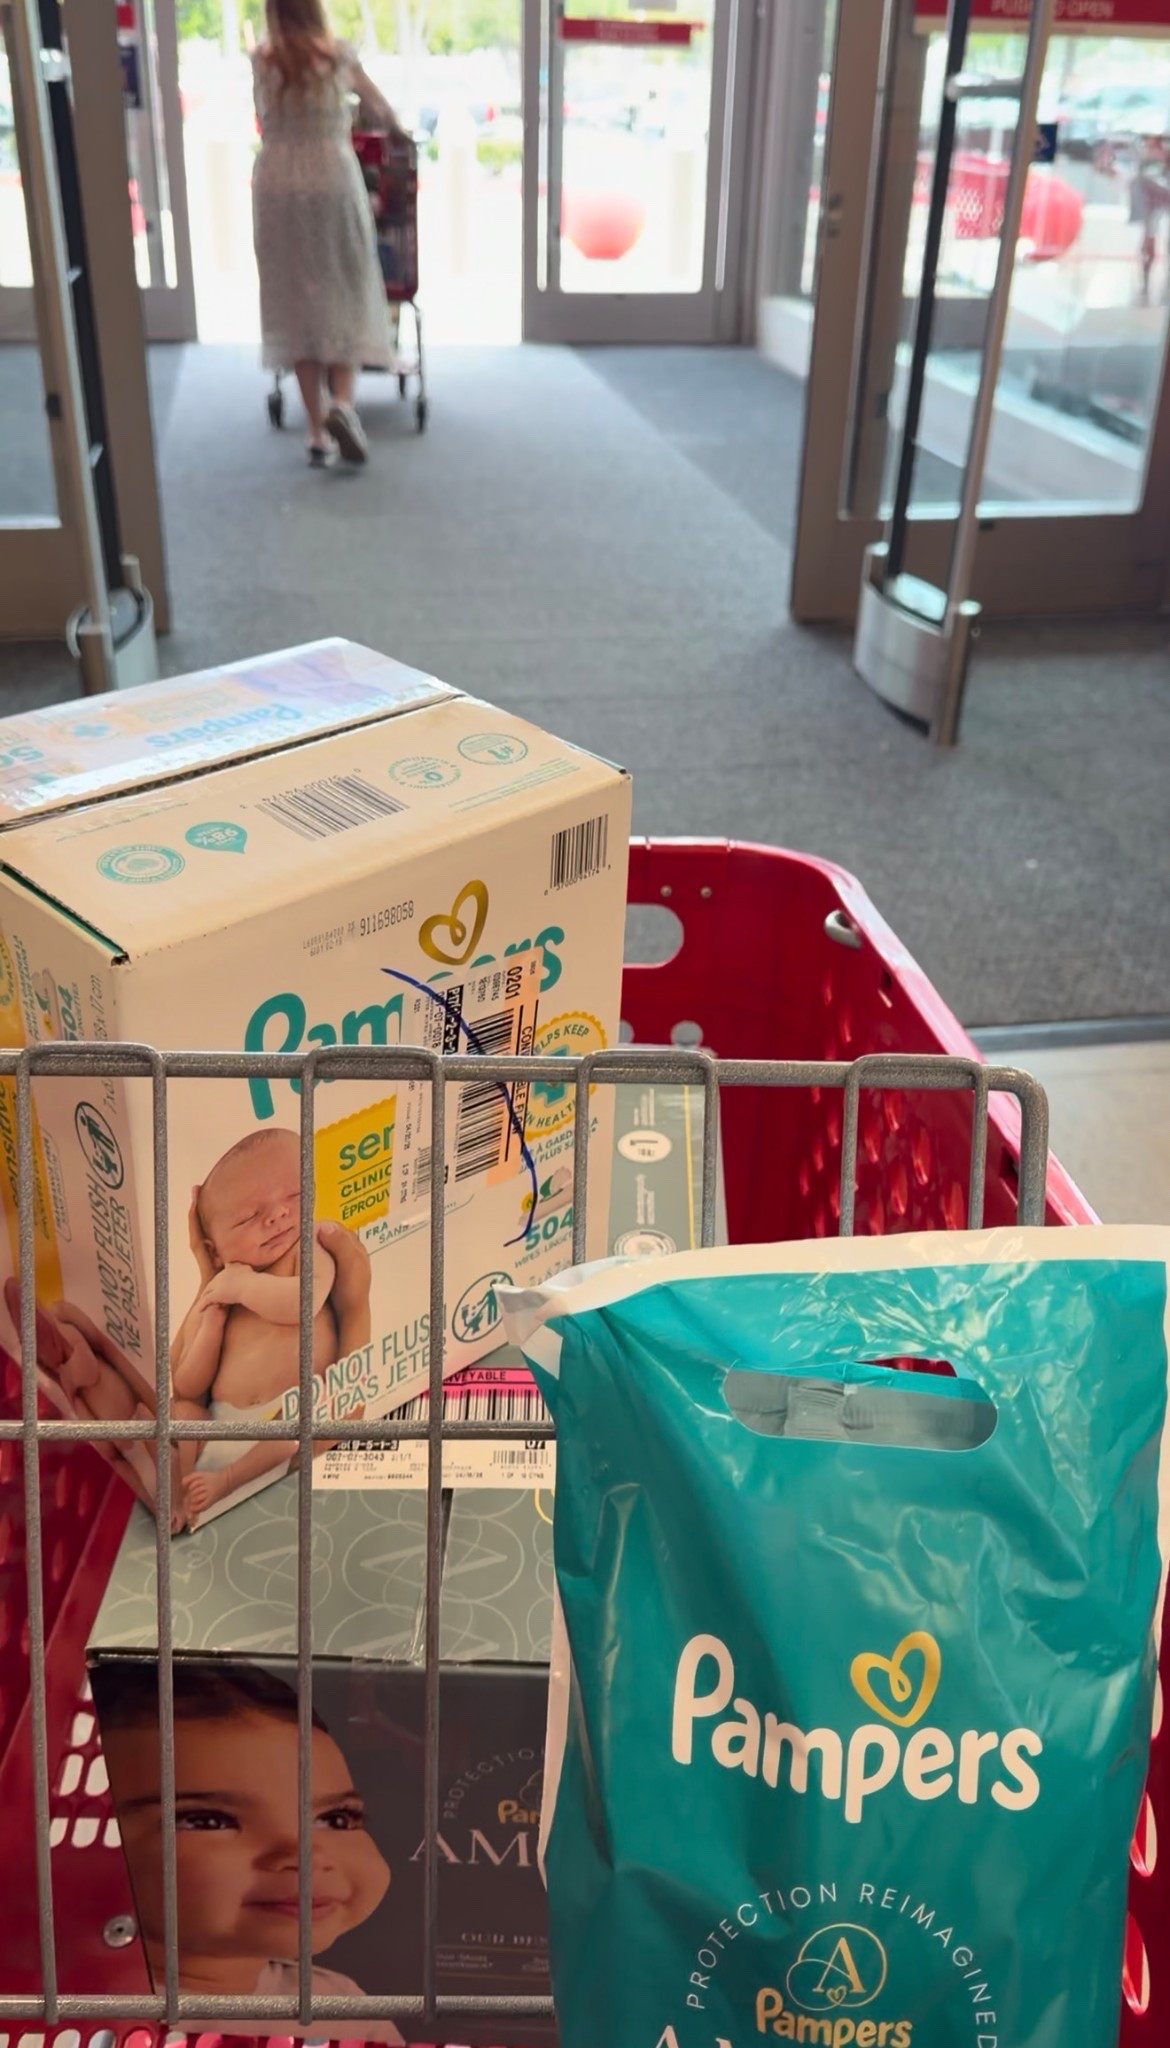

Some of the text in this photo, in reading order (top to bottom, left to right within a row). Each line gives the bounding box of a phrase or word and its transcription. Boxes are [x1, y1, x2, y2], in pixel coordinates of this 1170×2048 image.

[145, 702, 302, 749] Pampers
[360, 900, 414, 936] 911698058
[505, 966, 523, 1000] 0201
[563, 1023, 590, 1040] KEEP
[86, 1172, 126, 1349] DO NOT FLUSH
[110, 1196, 142, 1359] NE PAS JETER
[328, 1344, 374, 1396] NOT
[336, 1375, 379, 1415] PAS
[672, 1633, 1043, 1824] Pampers
[686, 1882, 837, 2010] PROTECTION
[755, 1987, 913, 2048] Pampers
